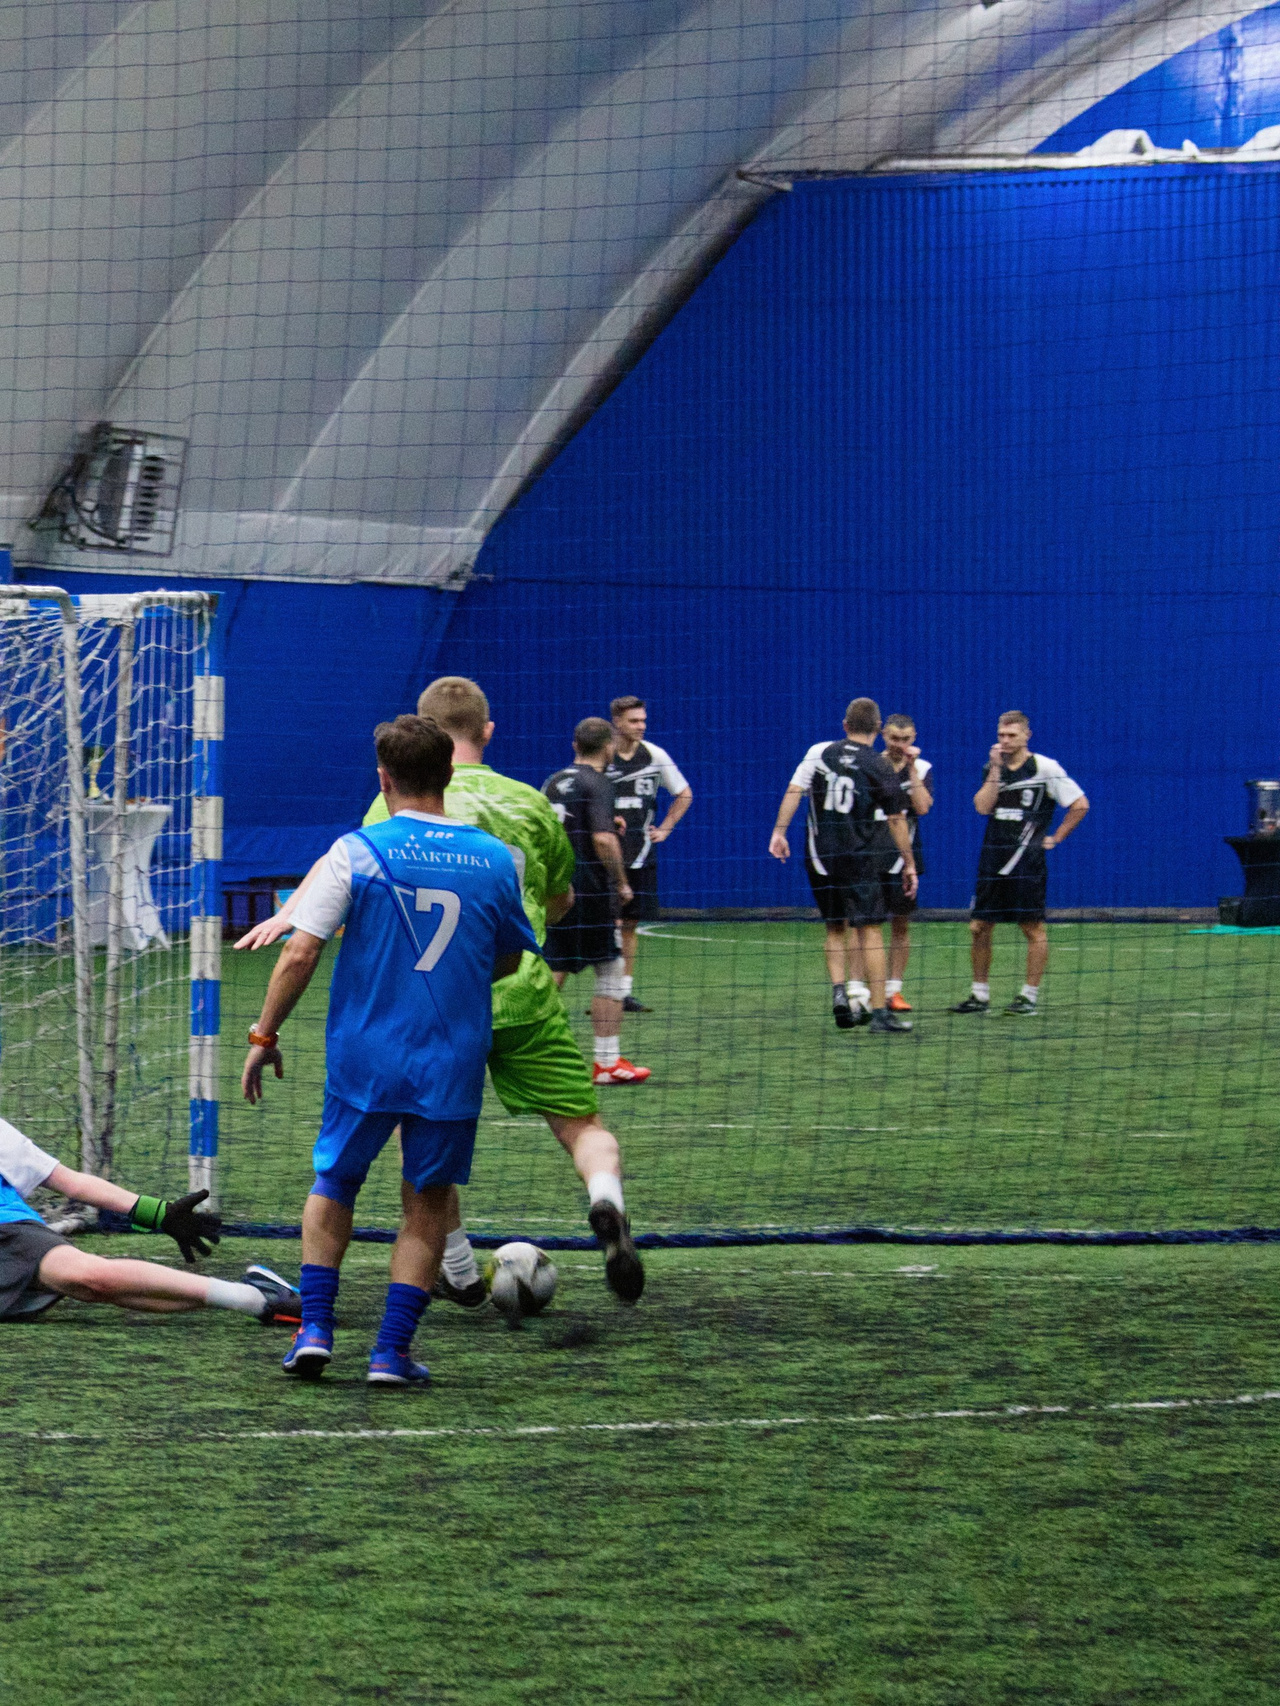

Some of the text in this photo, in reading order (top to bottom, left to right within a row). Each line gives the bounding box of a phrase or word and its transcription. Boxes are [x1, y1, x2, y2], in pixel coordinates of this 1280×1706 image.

[823, 773, 855, 814] 10
[387, 848, 491, 869] ГАЛАКТИКА
[414, 887, 461, 972] 7
